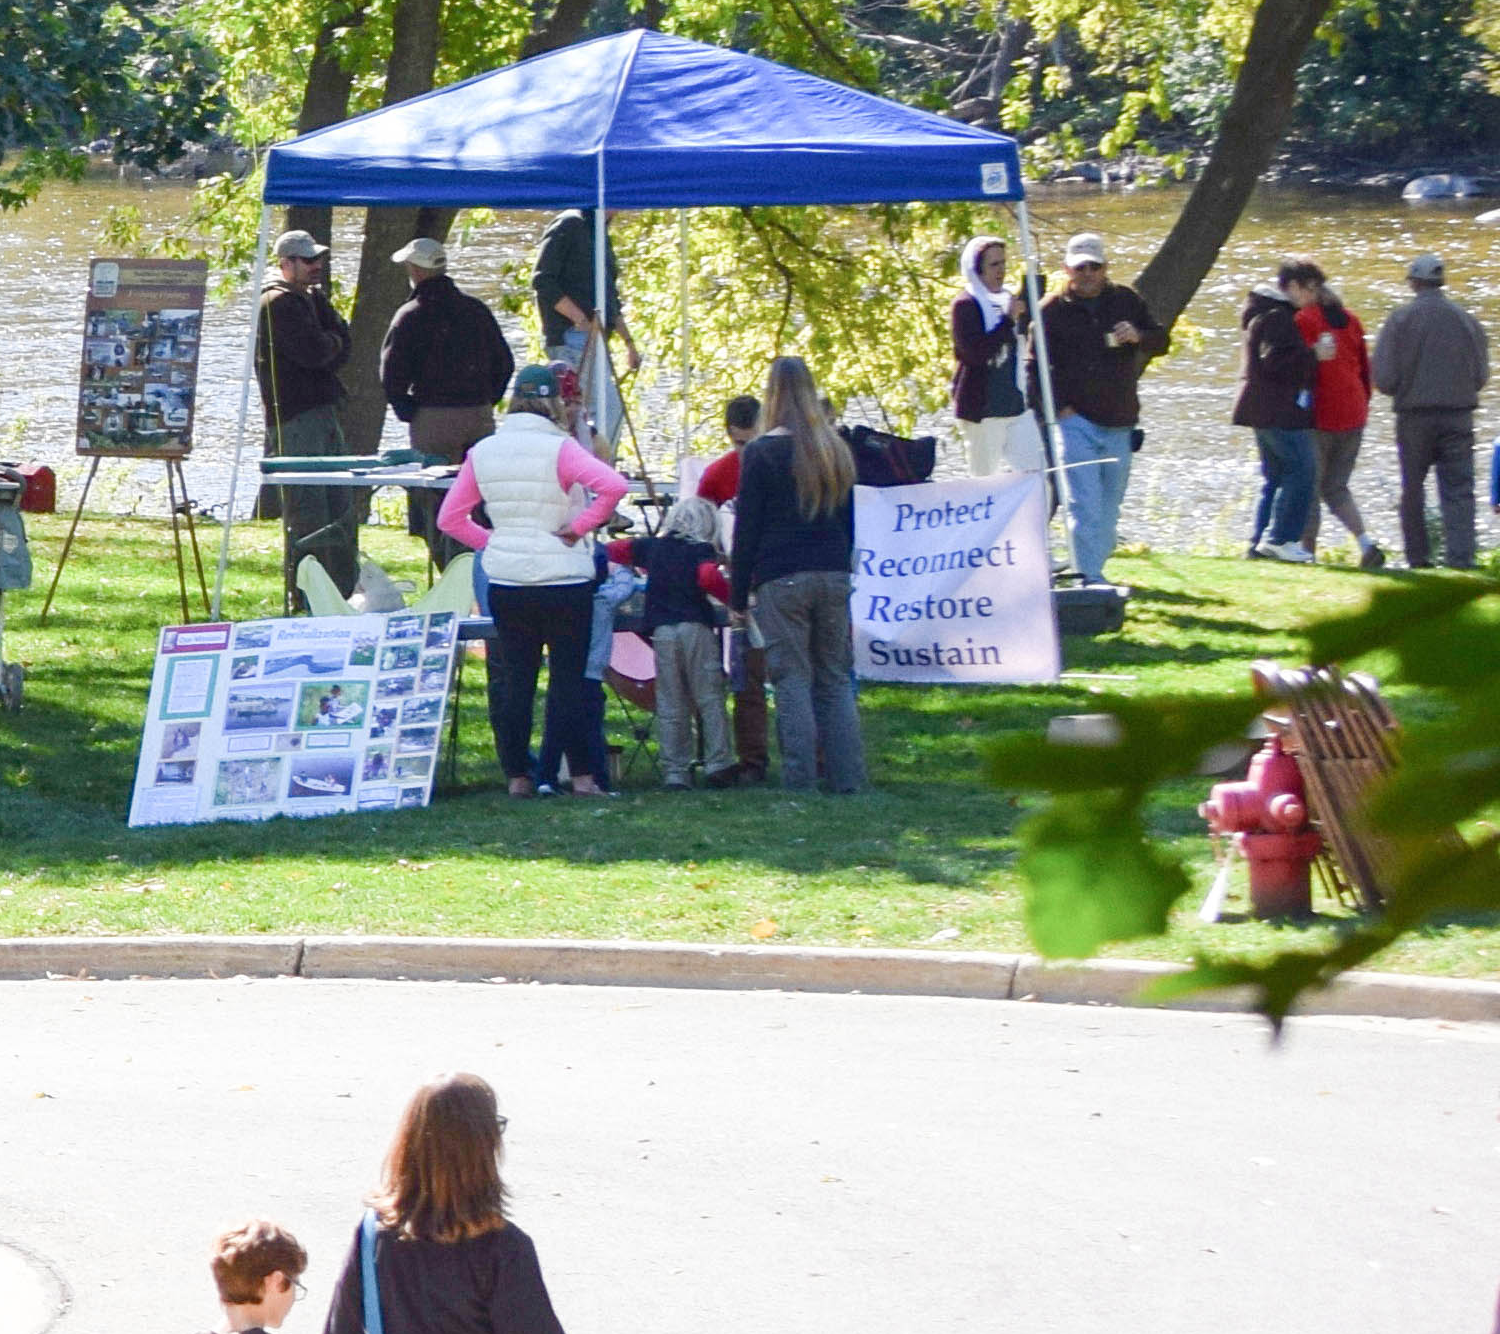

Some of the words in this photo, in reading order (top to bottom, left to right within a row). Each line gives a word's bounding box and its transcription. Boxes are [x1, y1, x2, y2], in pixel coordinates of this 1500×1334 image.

[892, 495, 995, 532] Protect
[857, 539, 1016, 577] Reconnect
[865, 594, 994, 623] Restore
[277, 627, 352, 640] Revitalization
[869, 637, 1002, 666] Sustain
